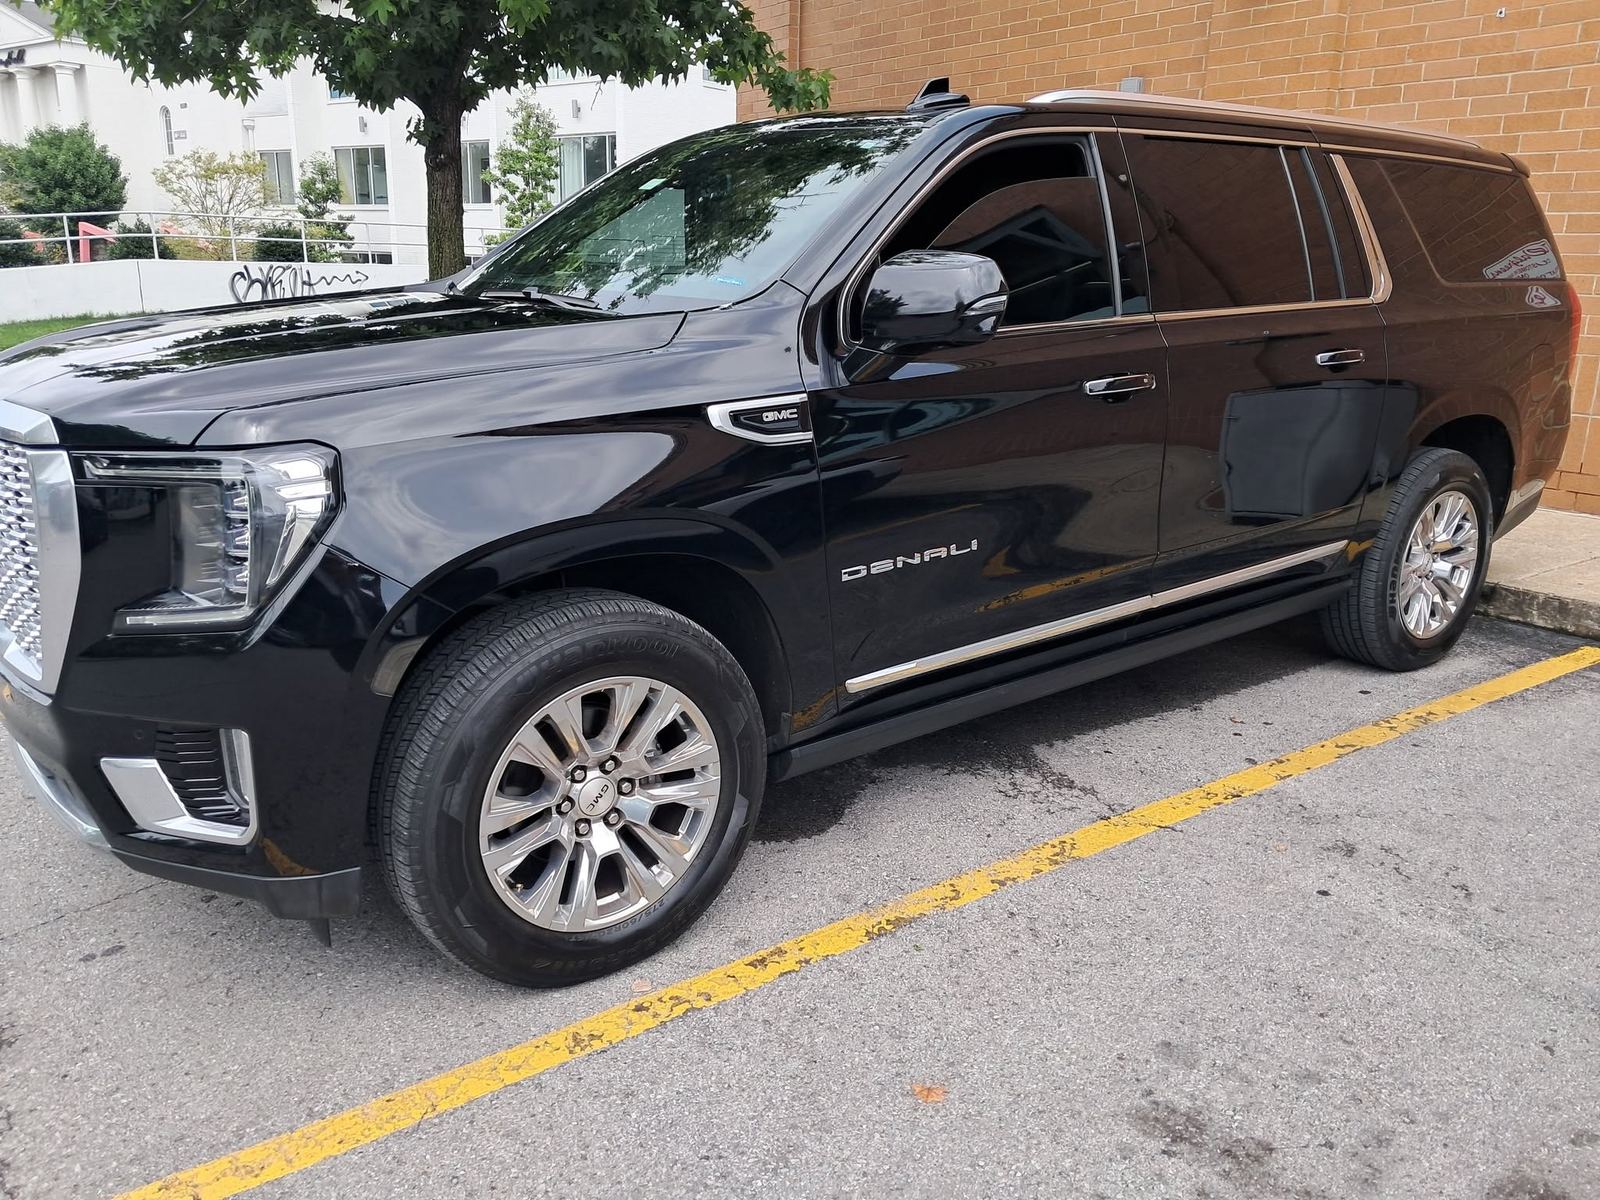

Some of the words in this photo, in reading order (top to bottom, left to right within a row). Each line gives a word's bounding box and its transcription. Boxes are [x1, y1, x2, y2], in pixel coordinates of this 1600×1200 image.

[762, 408, 798, 422] GMC
[841, 538, 978, 582] DENALI
[586, 784, 609, 811] GMC
